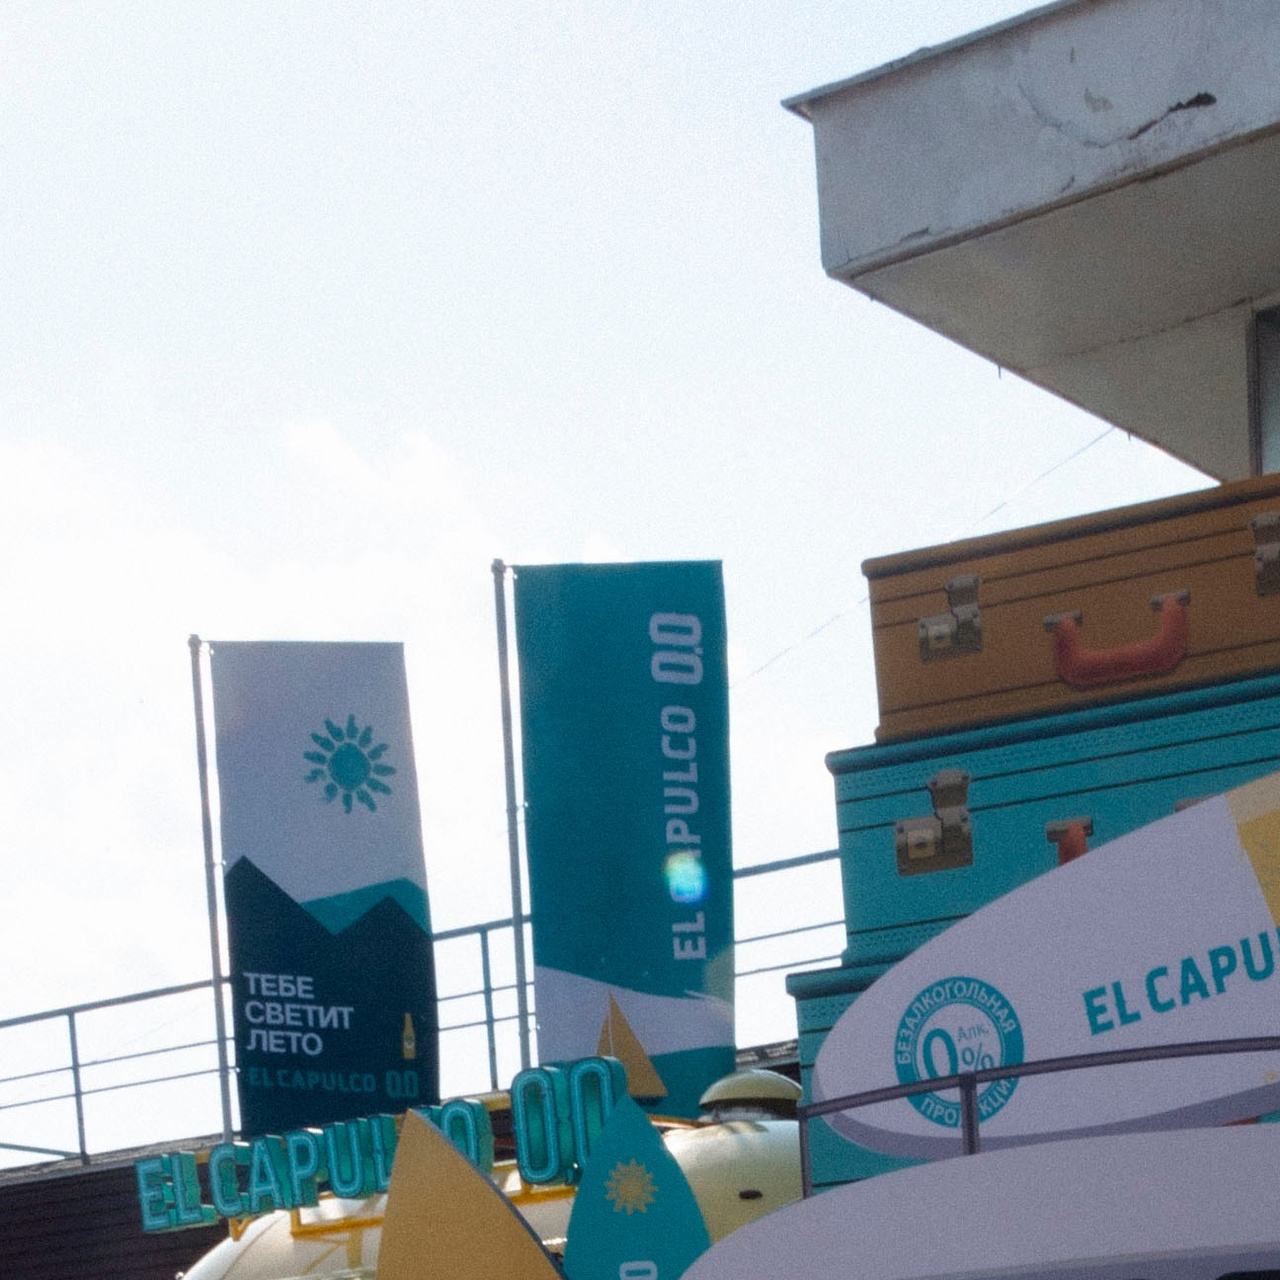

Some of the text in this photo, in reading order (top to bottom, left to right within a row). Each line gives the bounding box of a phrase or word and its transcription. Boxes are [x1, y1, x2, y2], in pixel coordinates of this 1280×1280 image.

[672, 910, 706, 960] EL
[243, 972, 315, 999] ТЕБЕ
[245, 1001, 354, 1030] СВЕТИТ
[898, 980, 1017, 1065] БЕЗАЛКОГОЛЬНАЯ
[1082, 980, 1142, 1036] EL
[247, 1029, 323, 1056] ЛЕТО
[277, 1069, 377, 1093] CAPULCO
[135, 1150, 212, 1232] EL
[207, 1099, 484, 1218] CAPULO
